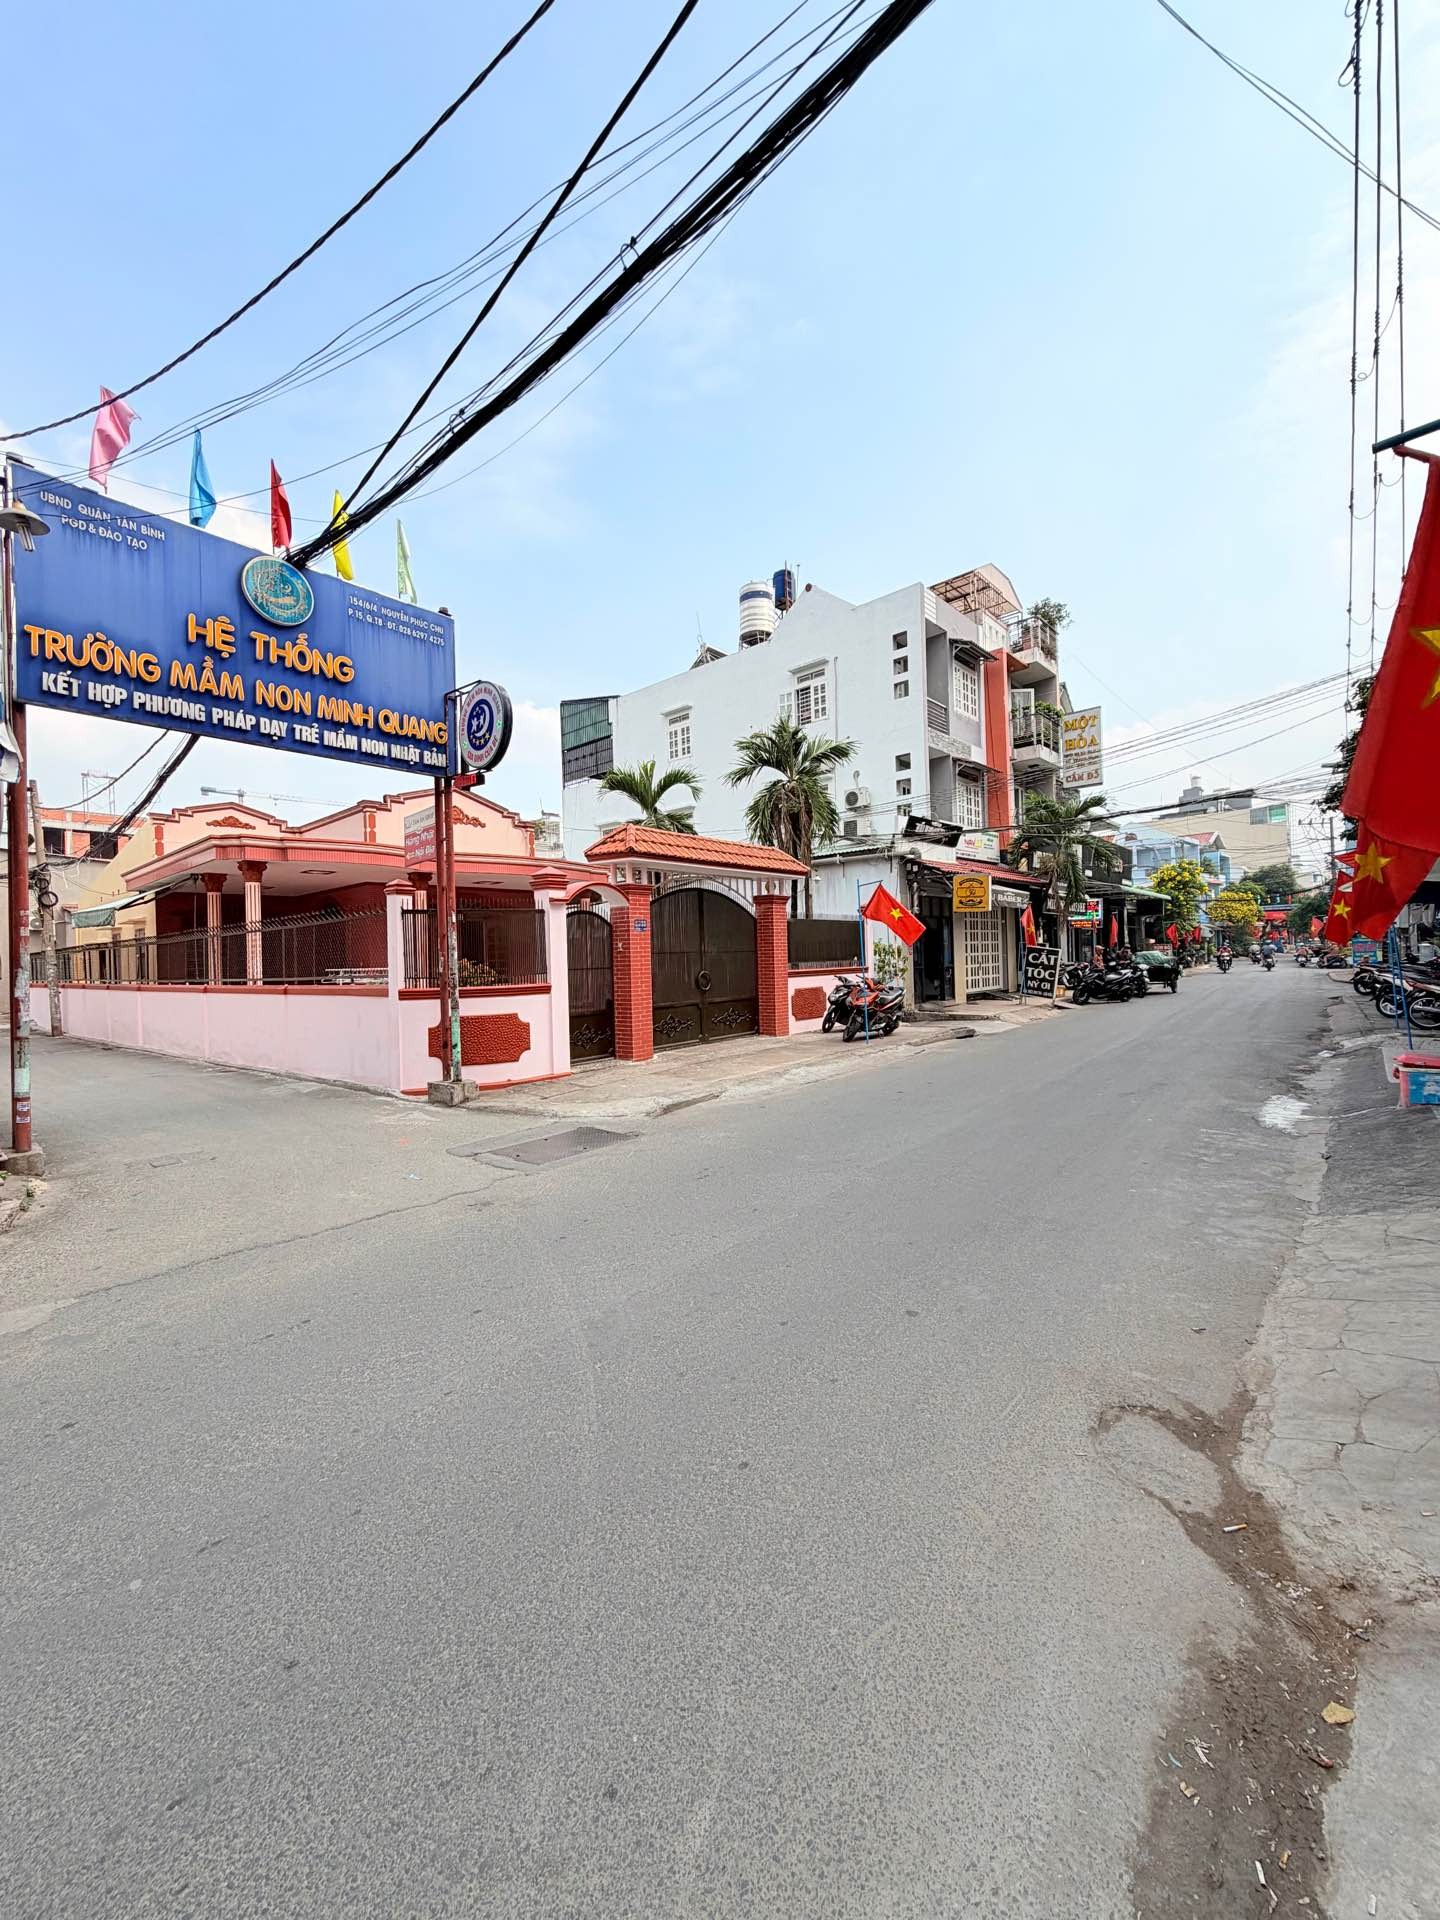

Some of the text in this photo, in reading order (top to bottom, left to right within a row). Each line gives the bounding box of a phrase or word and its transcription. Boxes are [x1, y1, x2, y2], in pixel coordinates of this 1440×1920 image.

[40, 490, 72, 509] UBND
[78, 503, 111, 522] QUẬN
[140, 523, 165, 541] BÌNH
[61, 514, 148, 551] PGD & ĐÀO TẠO
[349, 595, 444, 634] 154/6/4 NGUYỄN PHÚC CHU
[187, 612, 355, 683] HỆ THỐNG
[399, 625, 411, 635] 028
[412, 630, 427, 641] 6297
[429, 635, 445, 646] 4275
[23, 624, 449, 744] TRƯỜNG MẦM NON MINH QUANG
[42, 670, 447, 768] KẾT HỢP PHƯƠNG PHÁP DẠY TRẺ MẦM NON NHẬT BẢN
[1025, 965, 1056, 980] TÓC
[1028, 950, 1058, 966] CẮT
